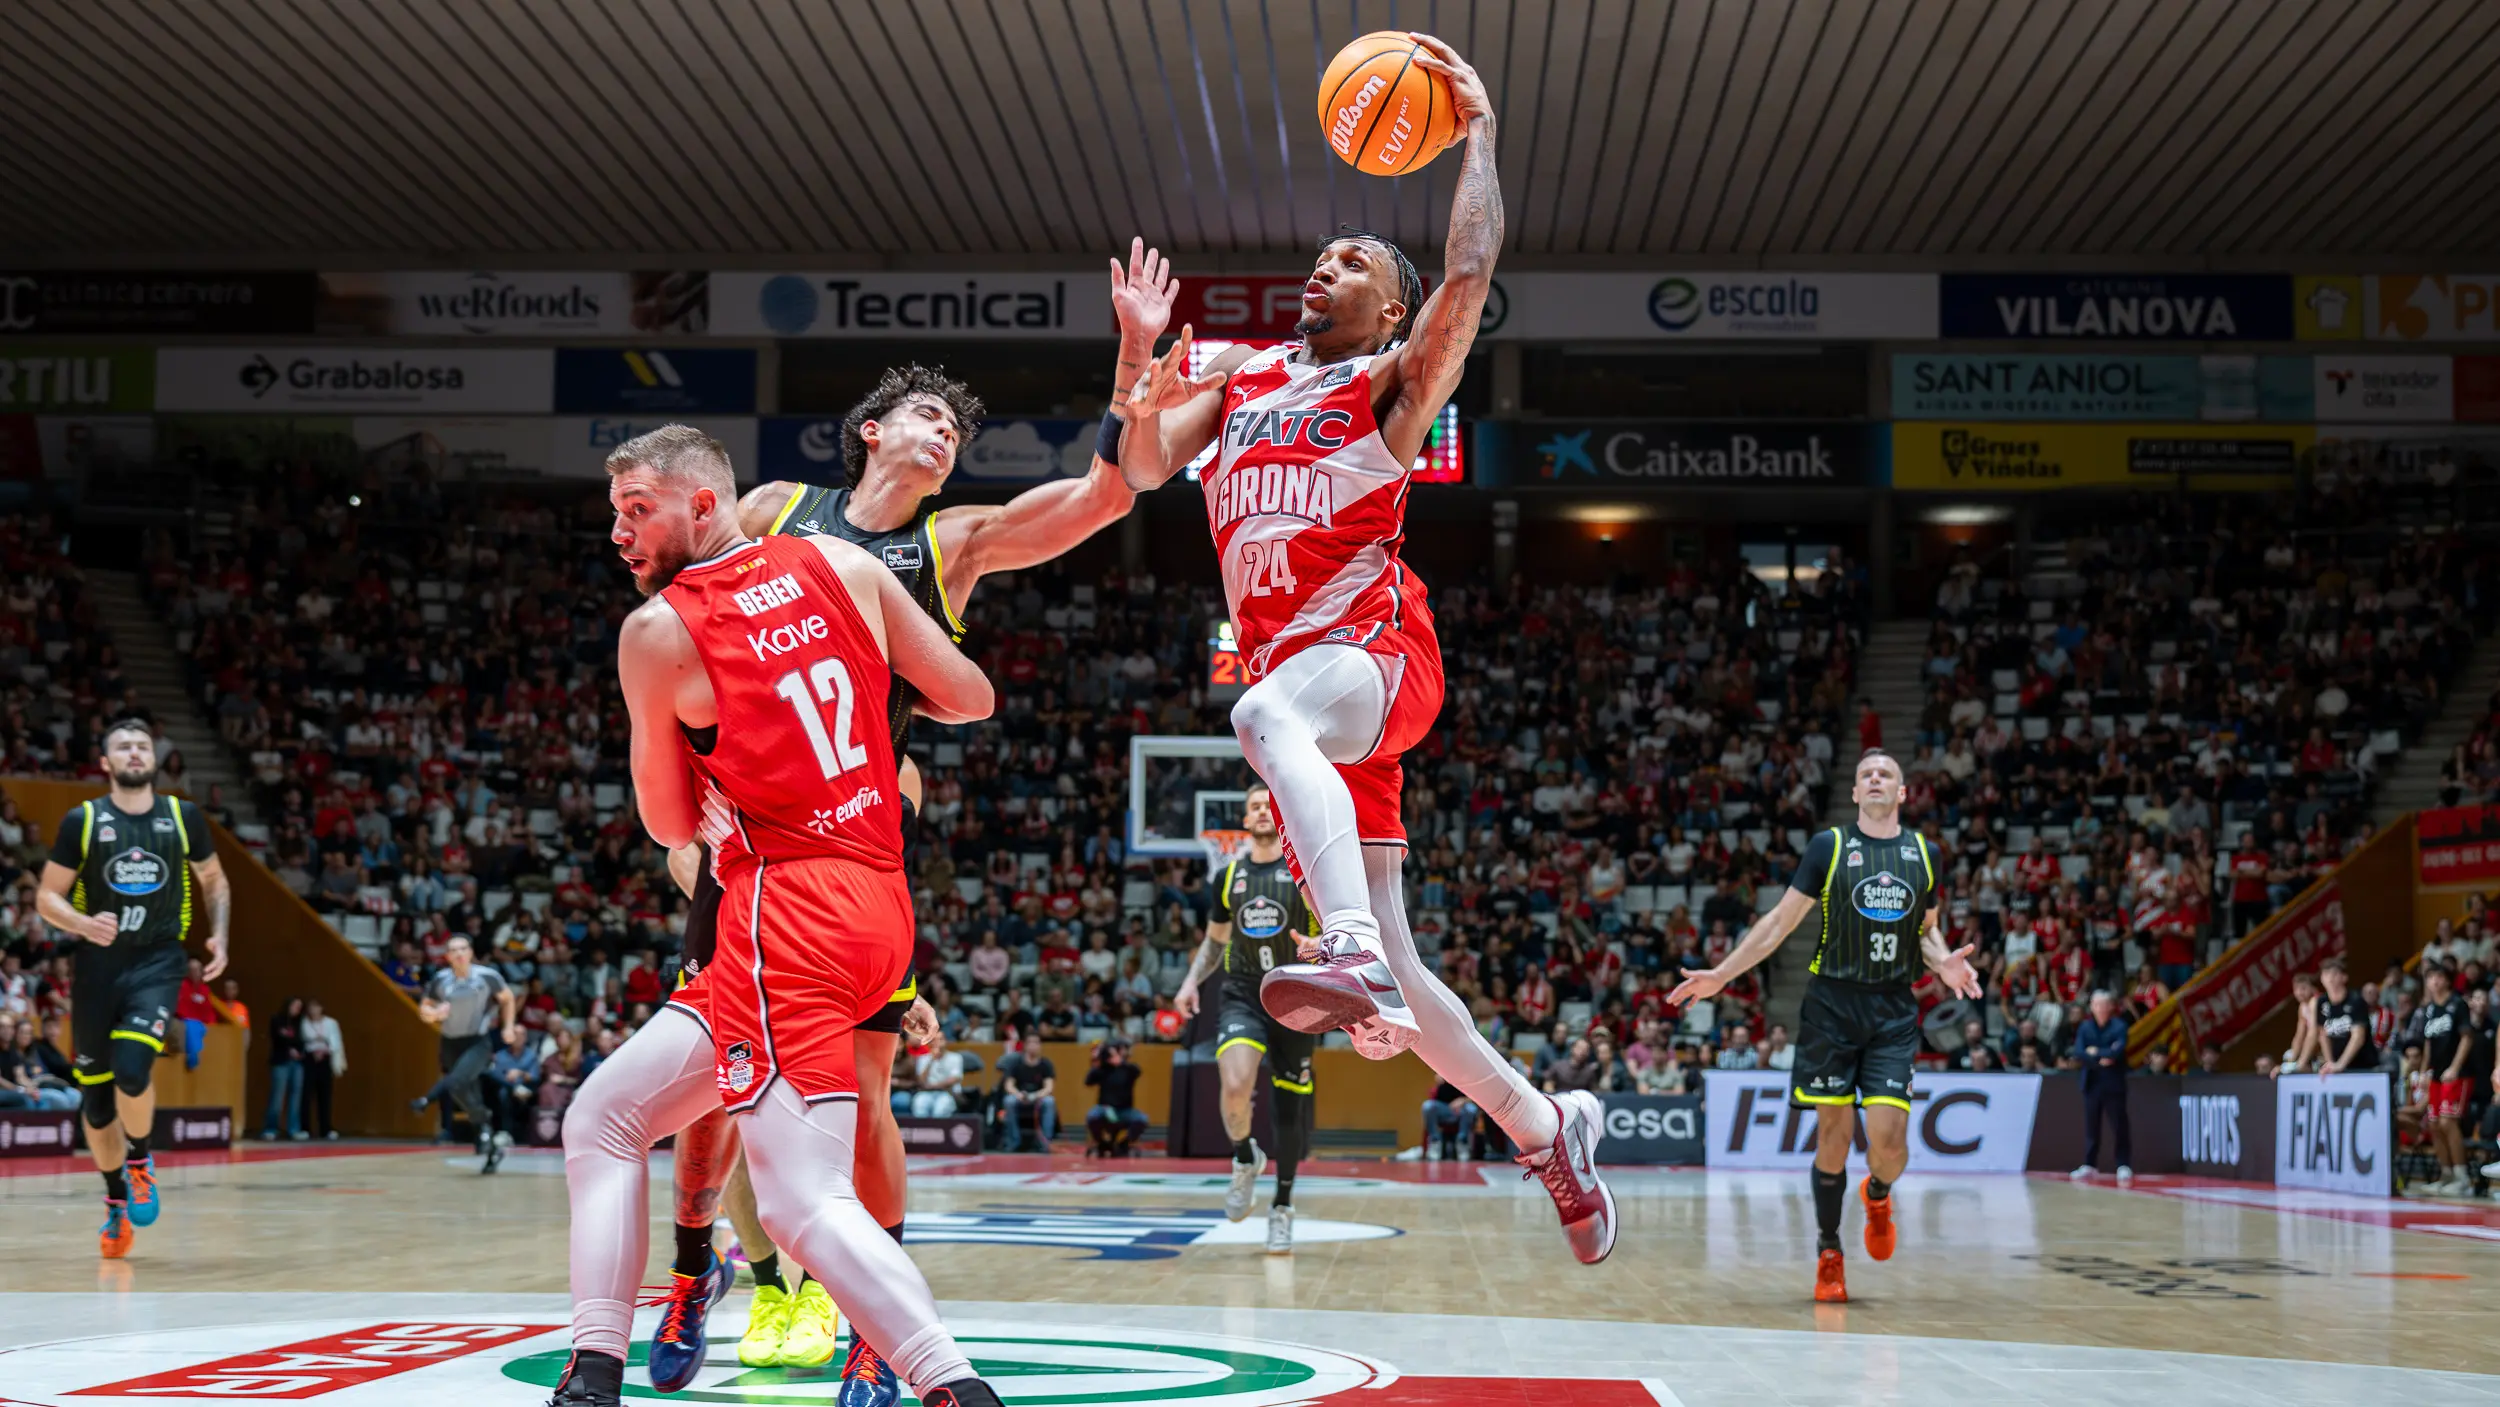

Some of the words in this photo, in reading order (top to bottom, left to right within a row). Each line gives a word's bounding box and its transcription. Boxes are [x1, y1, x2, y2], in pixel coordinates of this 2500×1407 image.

[1331, 74, 1387, 155] Wilson
[1400, 96, 1411, 116] NXT
[418, 284, 600, 319] weRfoods
[826, 281, 1065, 329] Tecnical
[1708, 277, 1819, 317] escala
[1996, 295, 2238, 336] VILANOVA
[287, 357, 465, 391] Grabalosa
[1914, 360, 2021, 394] SANT
[2027, 362, 2157, 396] ANIOL
[1224, 408, 1353, 451] FIATC
[1604, 431, 1835, 478] CaixaBank
[1216, 463, 1334, 534] GIRONA
[887, 556, 920, 567] endesa
[1242, 538, 1298, 598] 24
[732, 572, 806, 617] GEBEN
[746, 614, 829, 662] Kave
[773, 655, 869, 784] 12
[1863, 883, 1907, 899] Estrella
[1864, 896, 1904, 910] Galicia
[119, 904, 148, 933] 10
[1258, 945, 1275, 972] 8
[1869, 931, 1899, 962] 33
[1727, 1087, 1990, 1156] FIC
[2288, 1091, 2378, 1176] FIATC
[124, 1322, 527, 1395] SPAR
